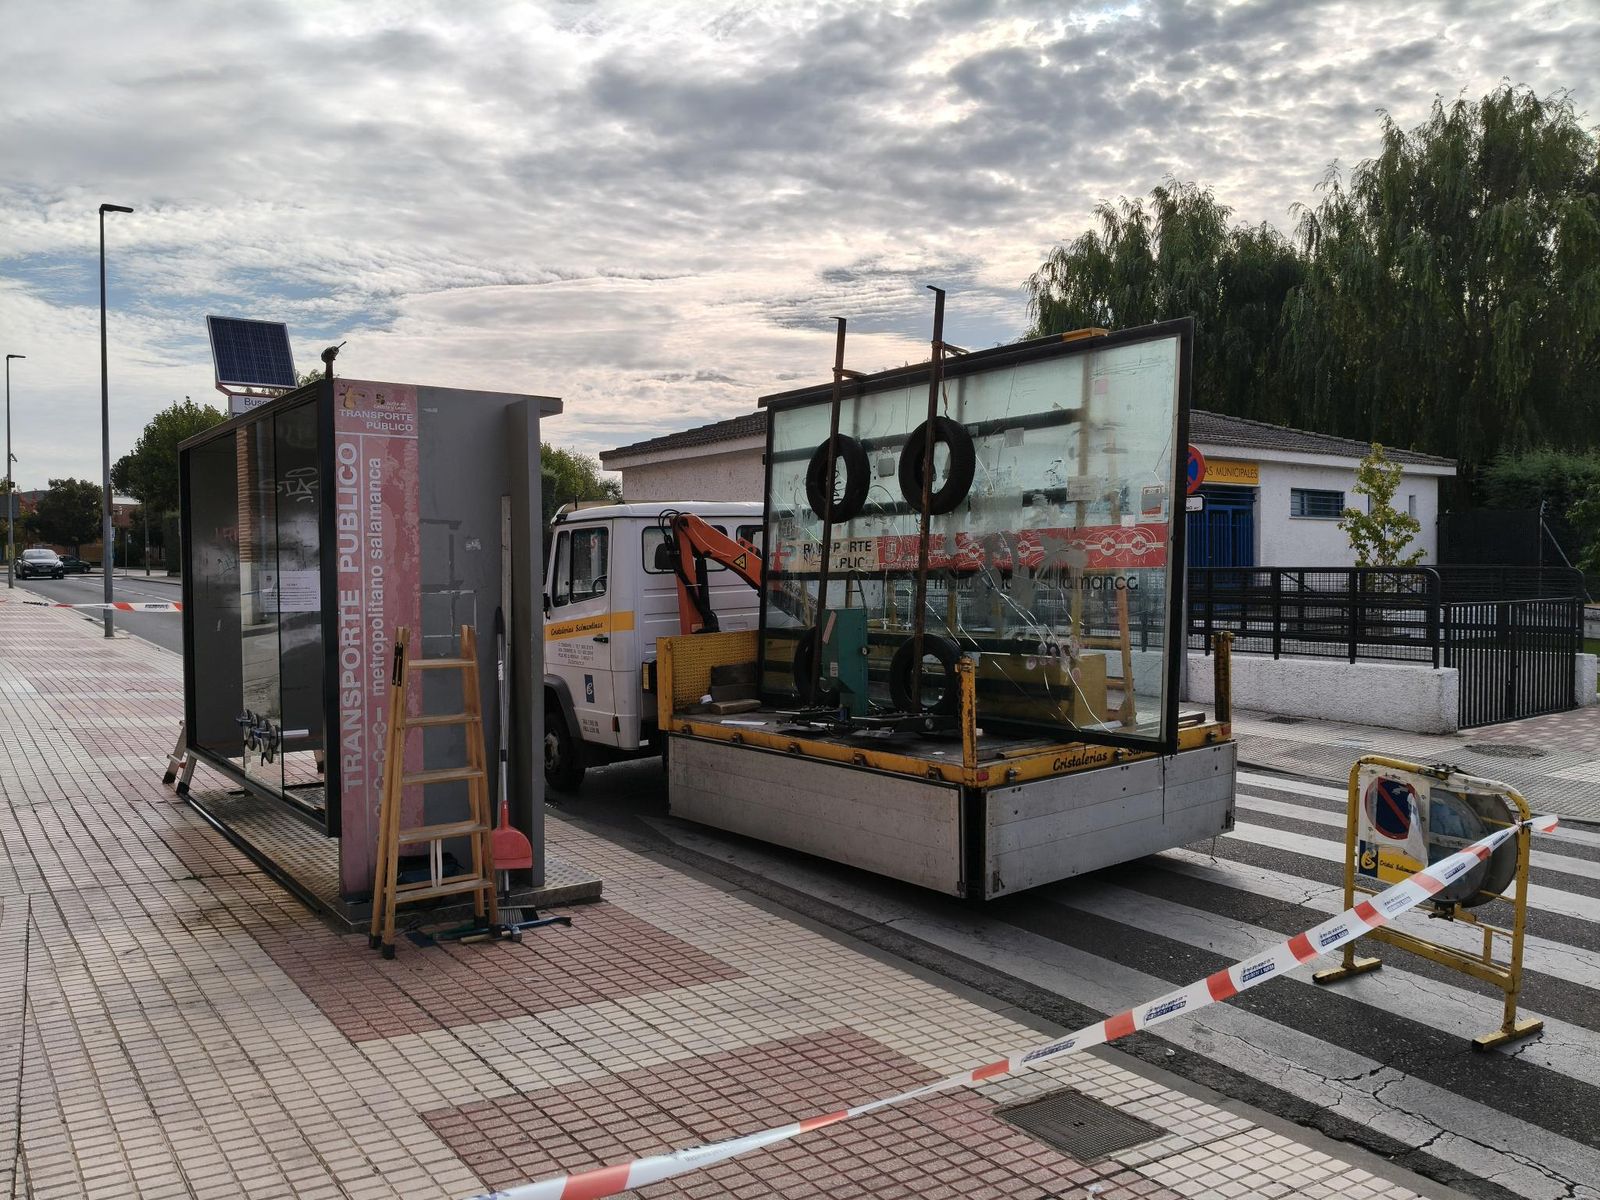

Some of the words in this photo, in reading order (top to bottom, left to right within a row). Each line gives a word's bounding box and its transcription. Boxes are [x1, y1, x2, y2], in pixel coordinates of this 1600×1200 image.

[339, 409, 413, 421] TRANSPORTE
[1216, 466, 1258, 479] MUNICIPALES
[367, 457, 383, 560] salamanca
[368, 565, 388, 697] metropolitano
[340, 589, 363, 794] TRANSPORTE
[1053, 751, 1108, 772] Cristalerias
